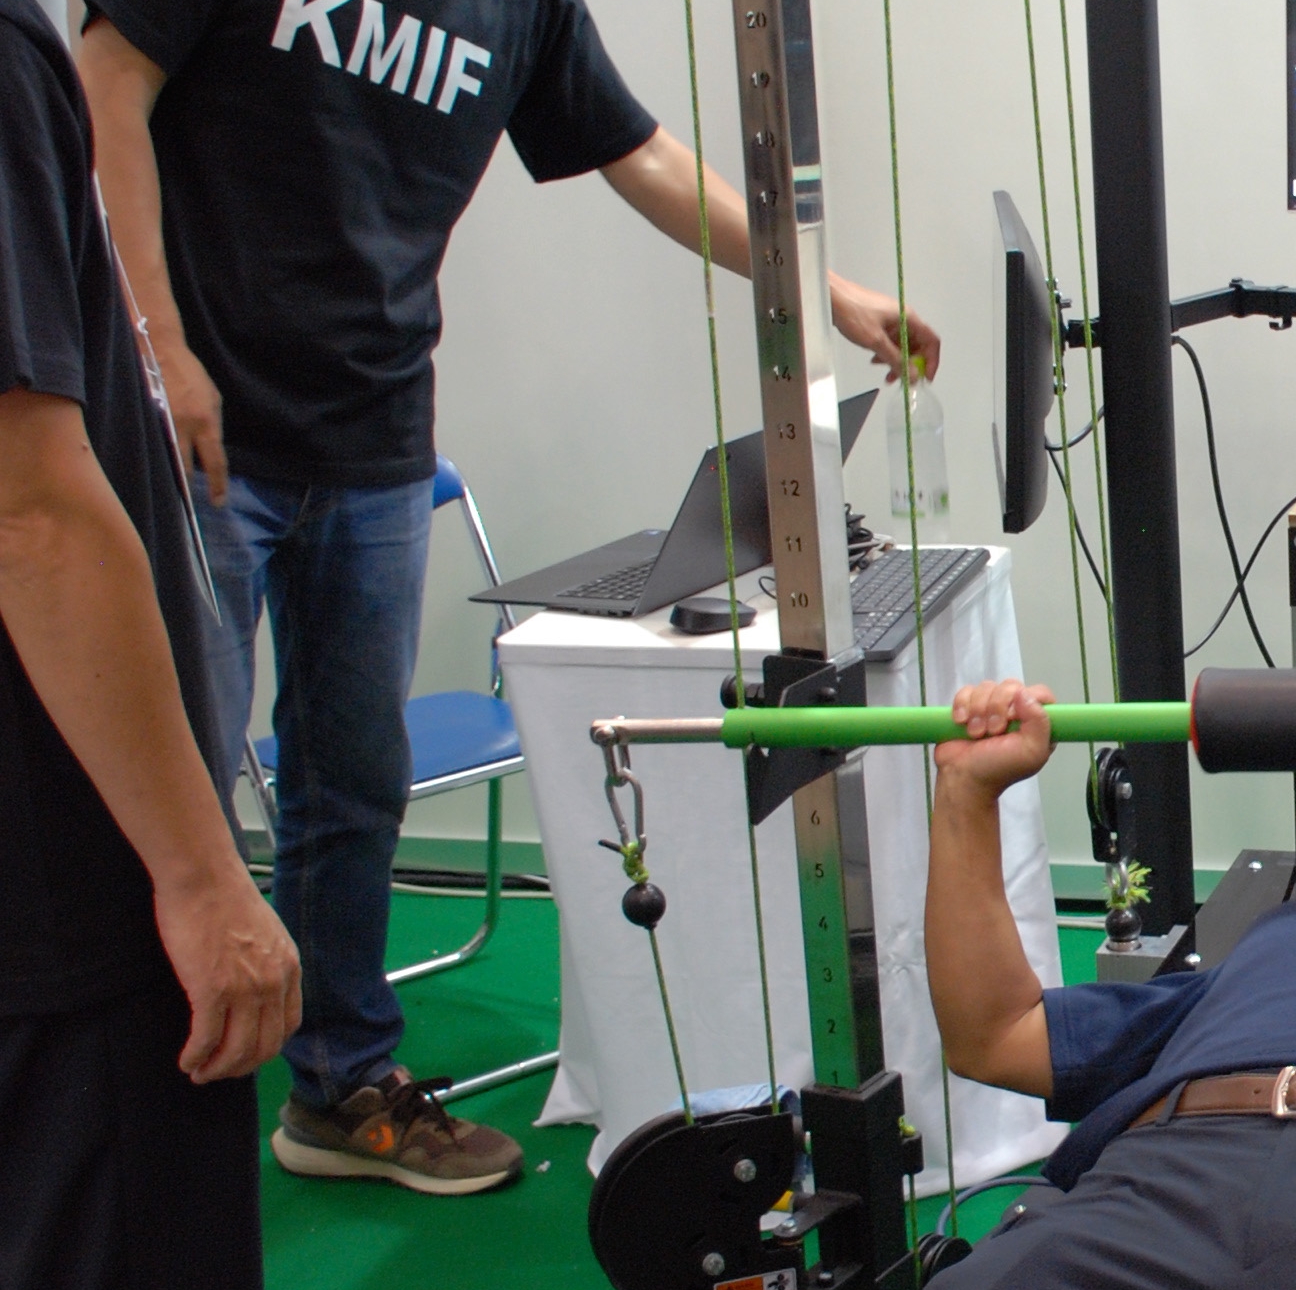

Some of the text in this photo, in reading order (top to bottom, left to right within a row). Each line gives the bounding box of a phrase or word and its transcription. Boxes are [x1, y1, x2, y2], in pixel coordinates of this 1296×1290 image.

[746, 11, 766, 28] 20
[751, 71, 770, 89] 19
[756, 130, 775, 149] 18
[760, 190, 778, 208] 17
[769, 307, 788, 325] 15
[773, 364, 792, 382] 14
[778, 422, 796, 440] 13
[781, 478, 800, 497] 12
[785, 536, 802, 552] 11
[790, 591, 808, 608] 10
[810, 810, 820, 826] 6
[815, 863, 824, 879] 5
[818, 916, 828, 931] 4
[823, 967, 832, 983] 3
[827, 1019, 836, 1034] 2
[831, 1070, 838, 1084] 1
